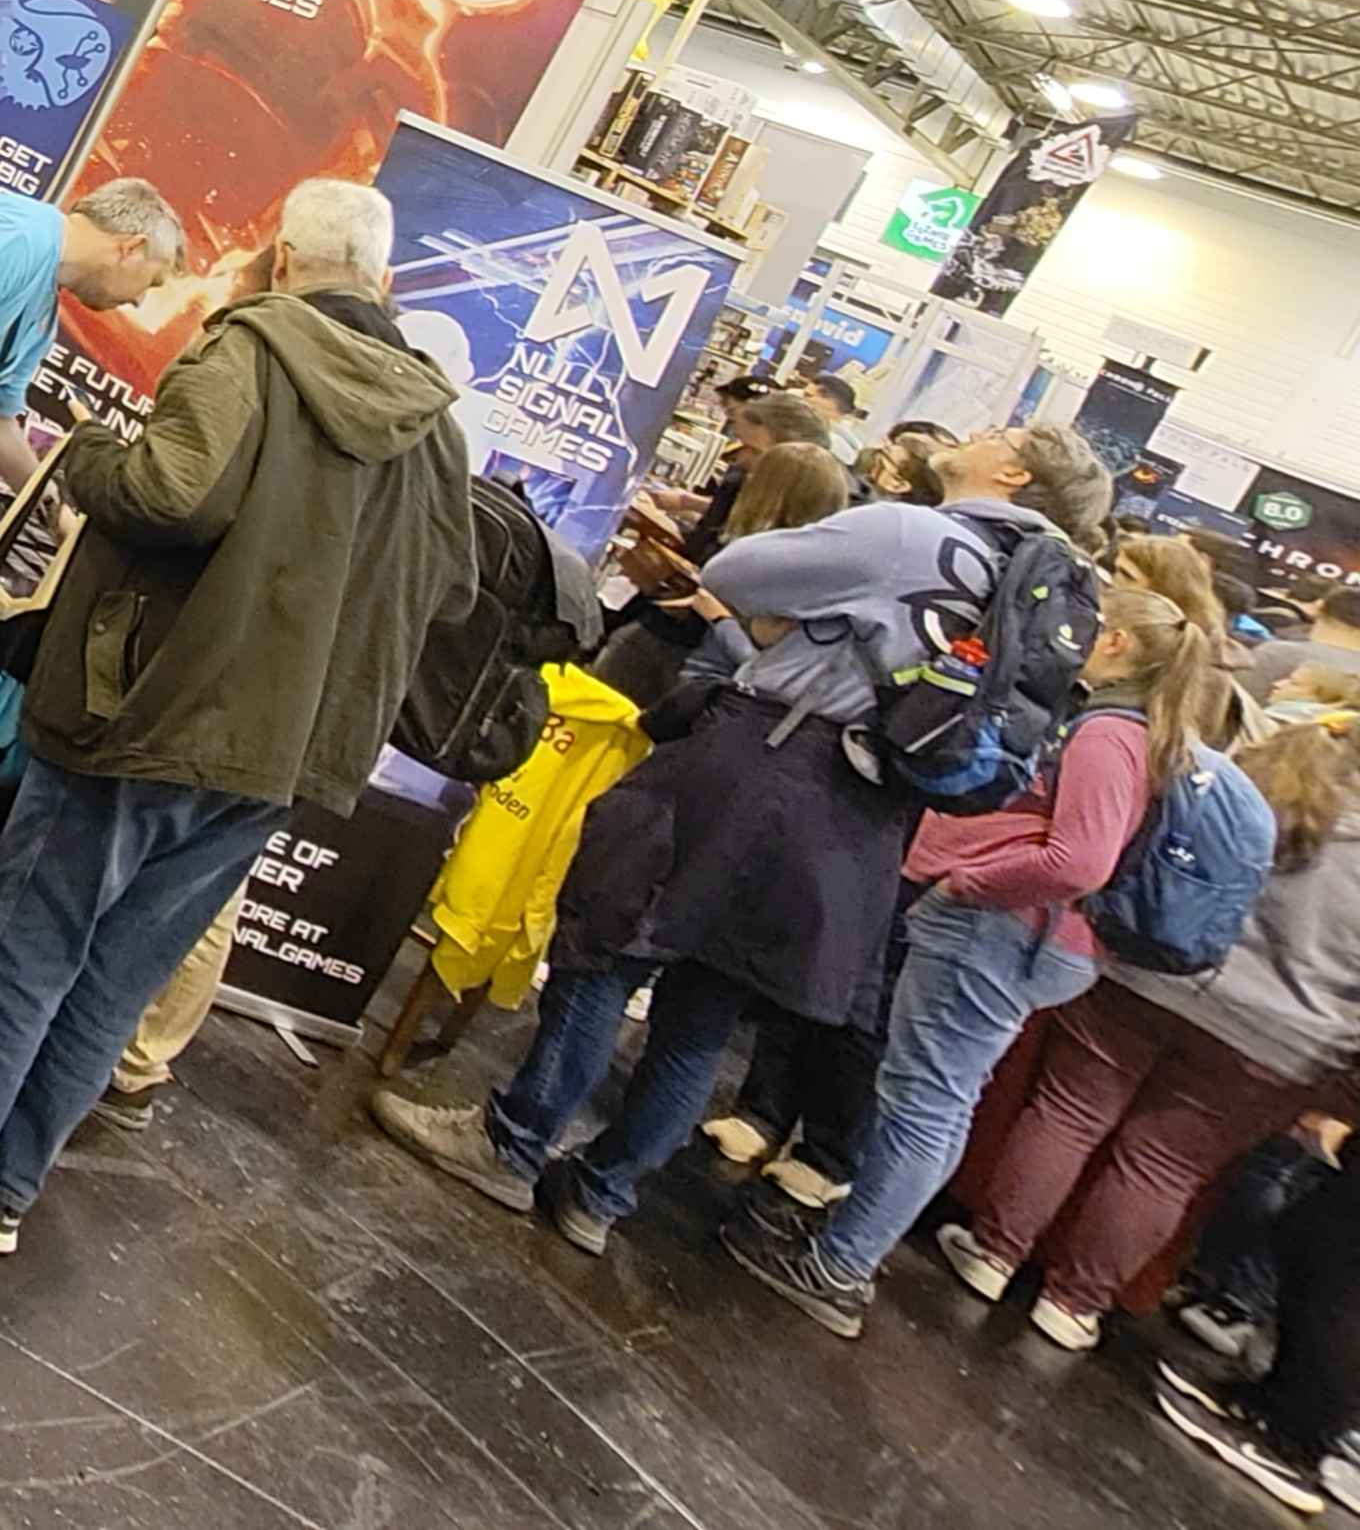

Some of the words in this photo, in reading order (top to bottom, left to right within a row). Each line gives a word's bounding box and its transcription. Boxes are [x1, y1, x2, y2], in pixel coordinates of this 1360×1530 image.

[510, 342, 604, 403] NULL
[495, 374, 630, 447] SIGNAL
[481, 409, 613, 473] GAMES
[1263, 501, 1305, 523] 8.0
[292, 840, 340, 869] OF
[237, 899, 291, 932] ORE
[290, 919, 329, 944] AT
